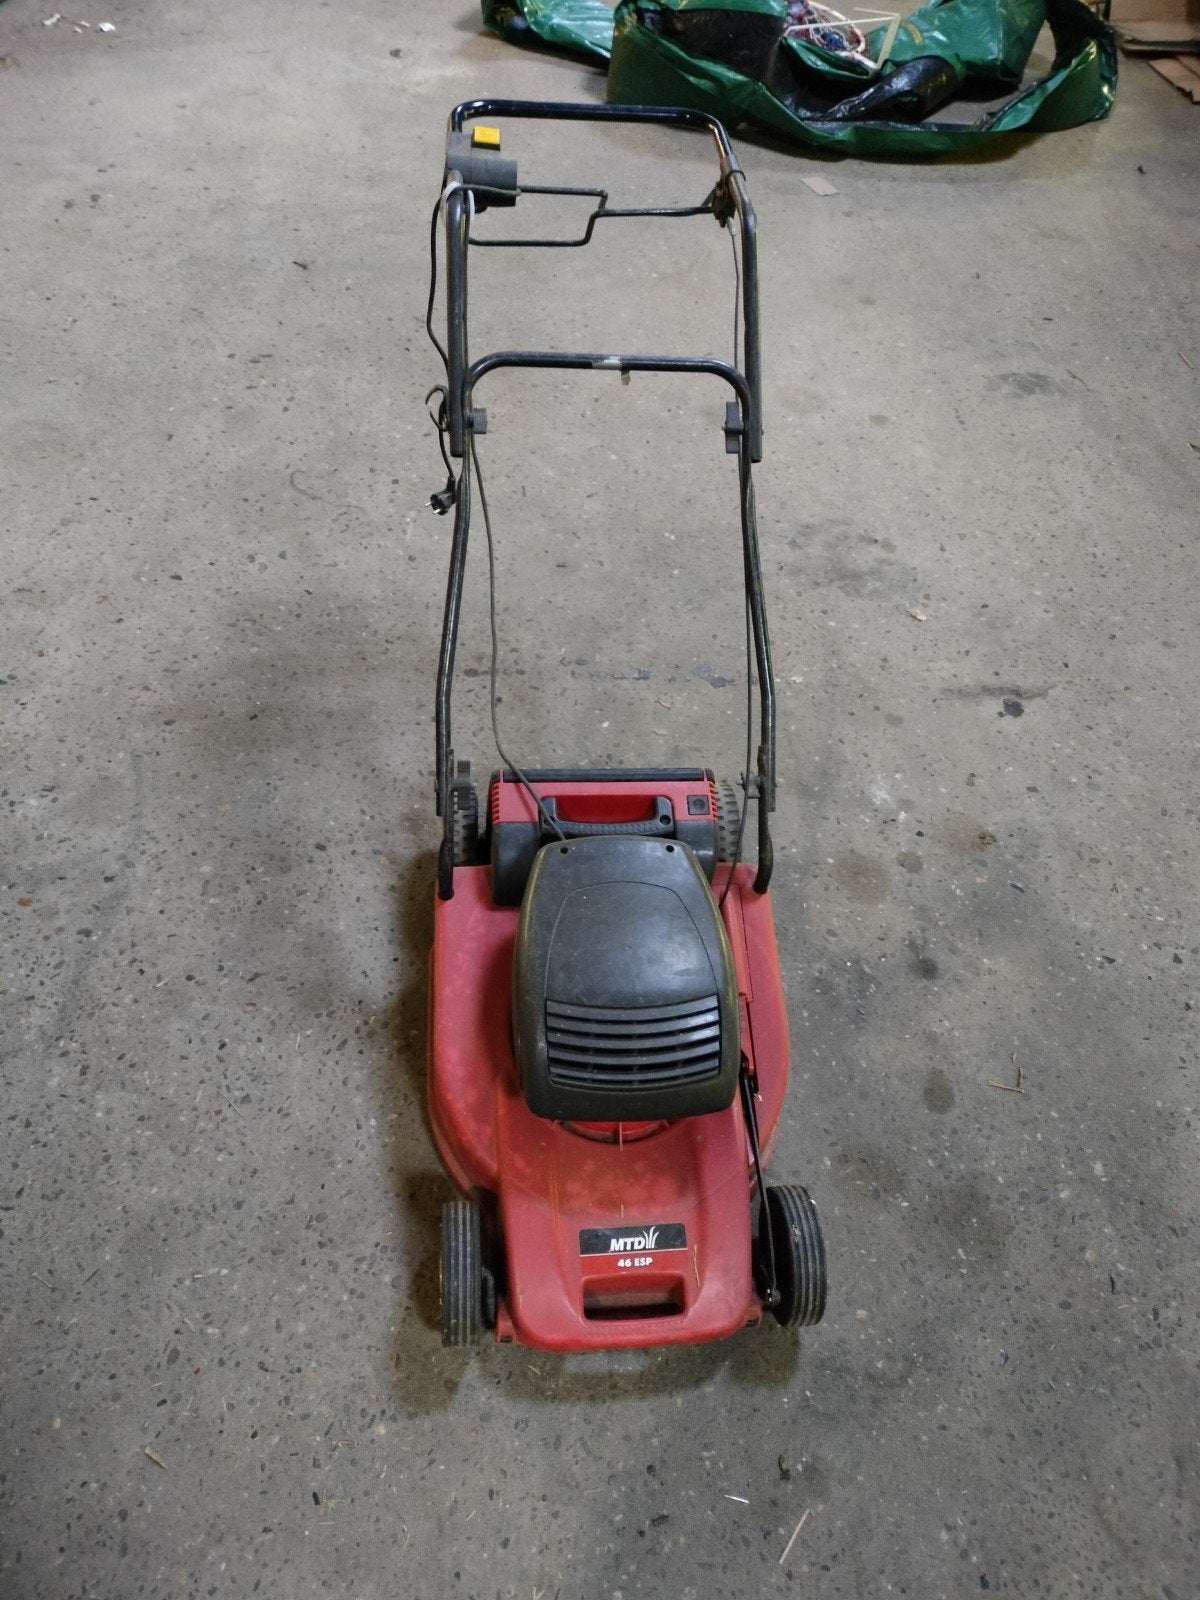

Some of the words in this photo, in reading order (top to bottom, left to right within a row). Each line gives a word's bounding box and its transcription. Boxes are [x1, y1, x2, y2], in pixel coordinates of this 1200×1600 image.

[609, 1236, 646, 1252] MTD
[617, 1259, 632, 1267] 46
[634, 1257, 653, 1267] ESP
